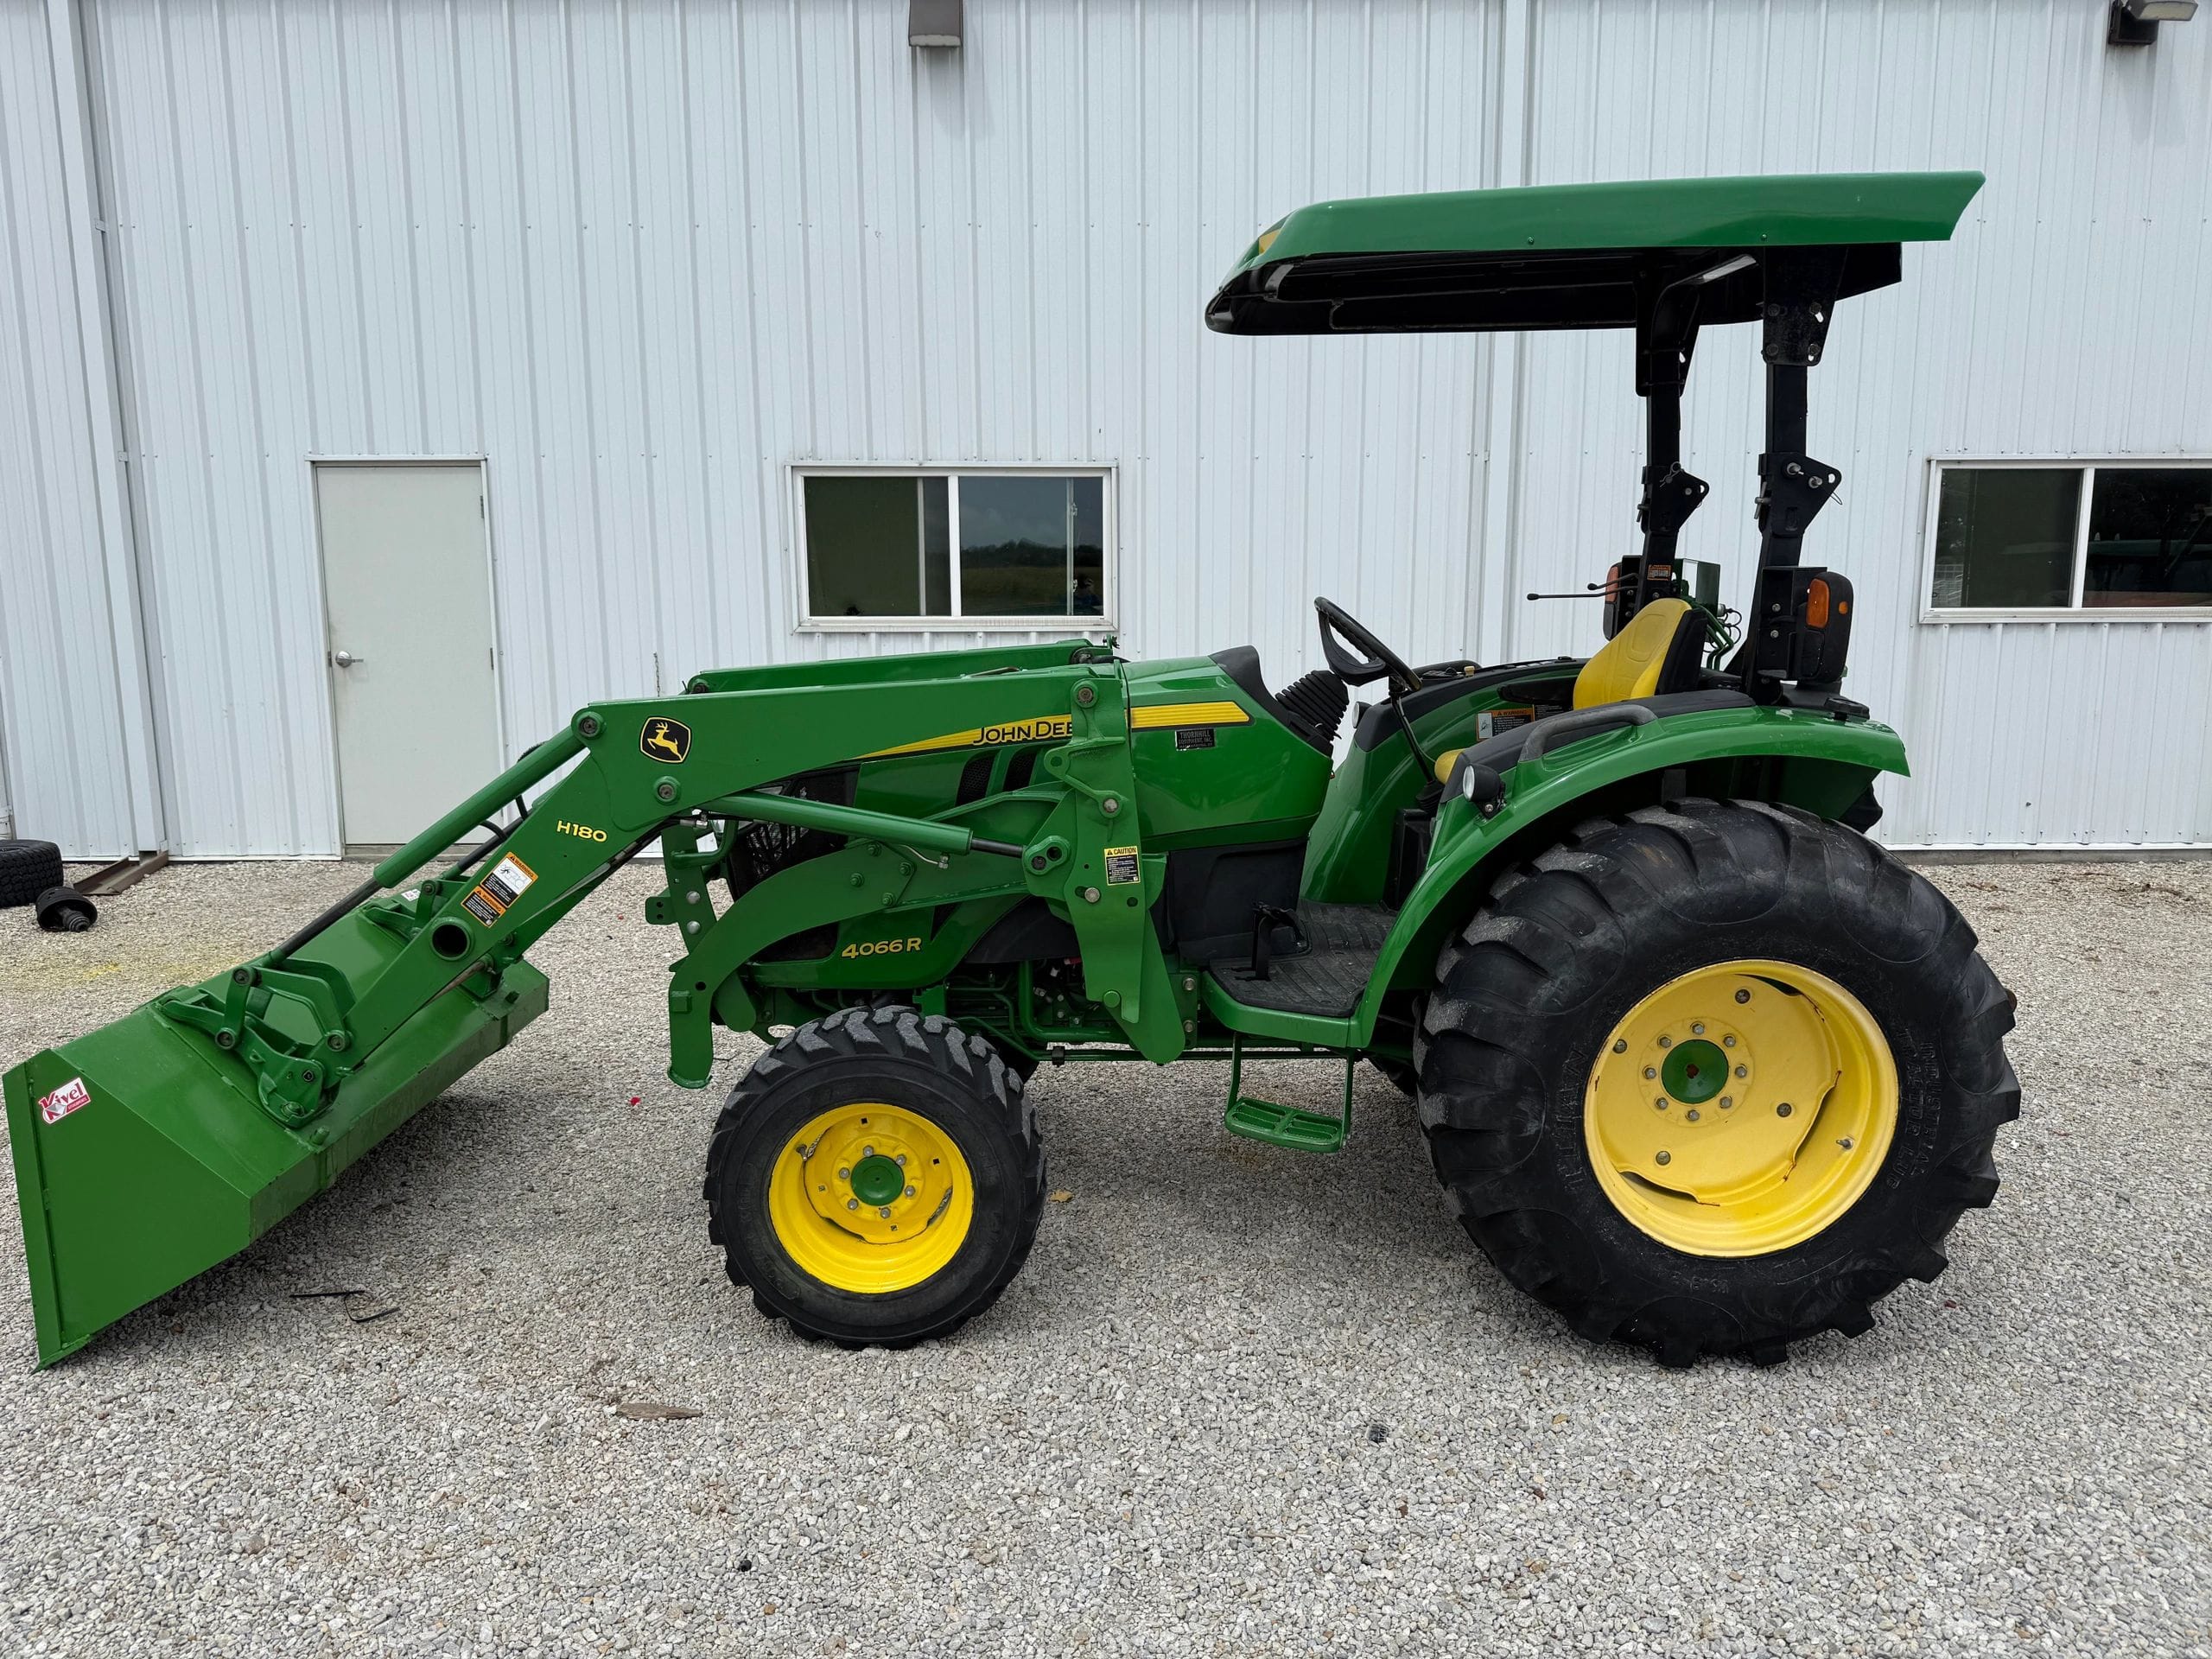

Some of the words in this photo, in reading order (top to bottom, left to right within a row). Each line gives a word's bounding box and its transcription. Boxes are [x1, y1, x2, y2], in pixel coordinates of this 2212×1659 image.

[973, 726, 1032, 745] JOHN
[556, 820, 607, 842] H180
[39, 1082, 84, 1121] Kivel
